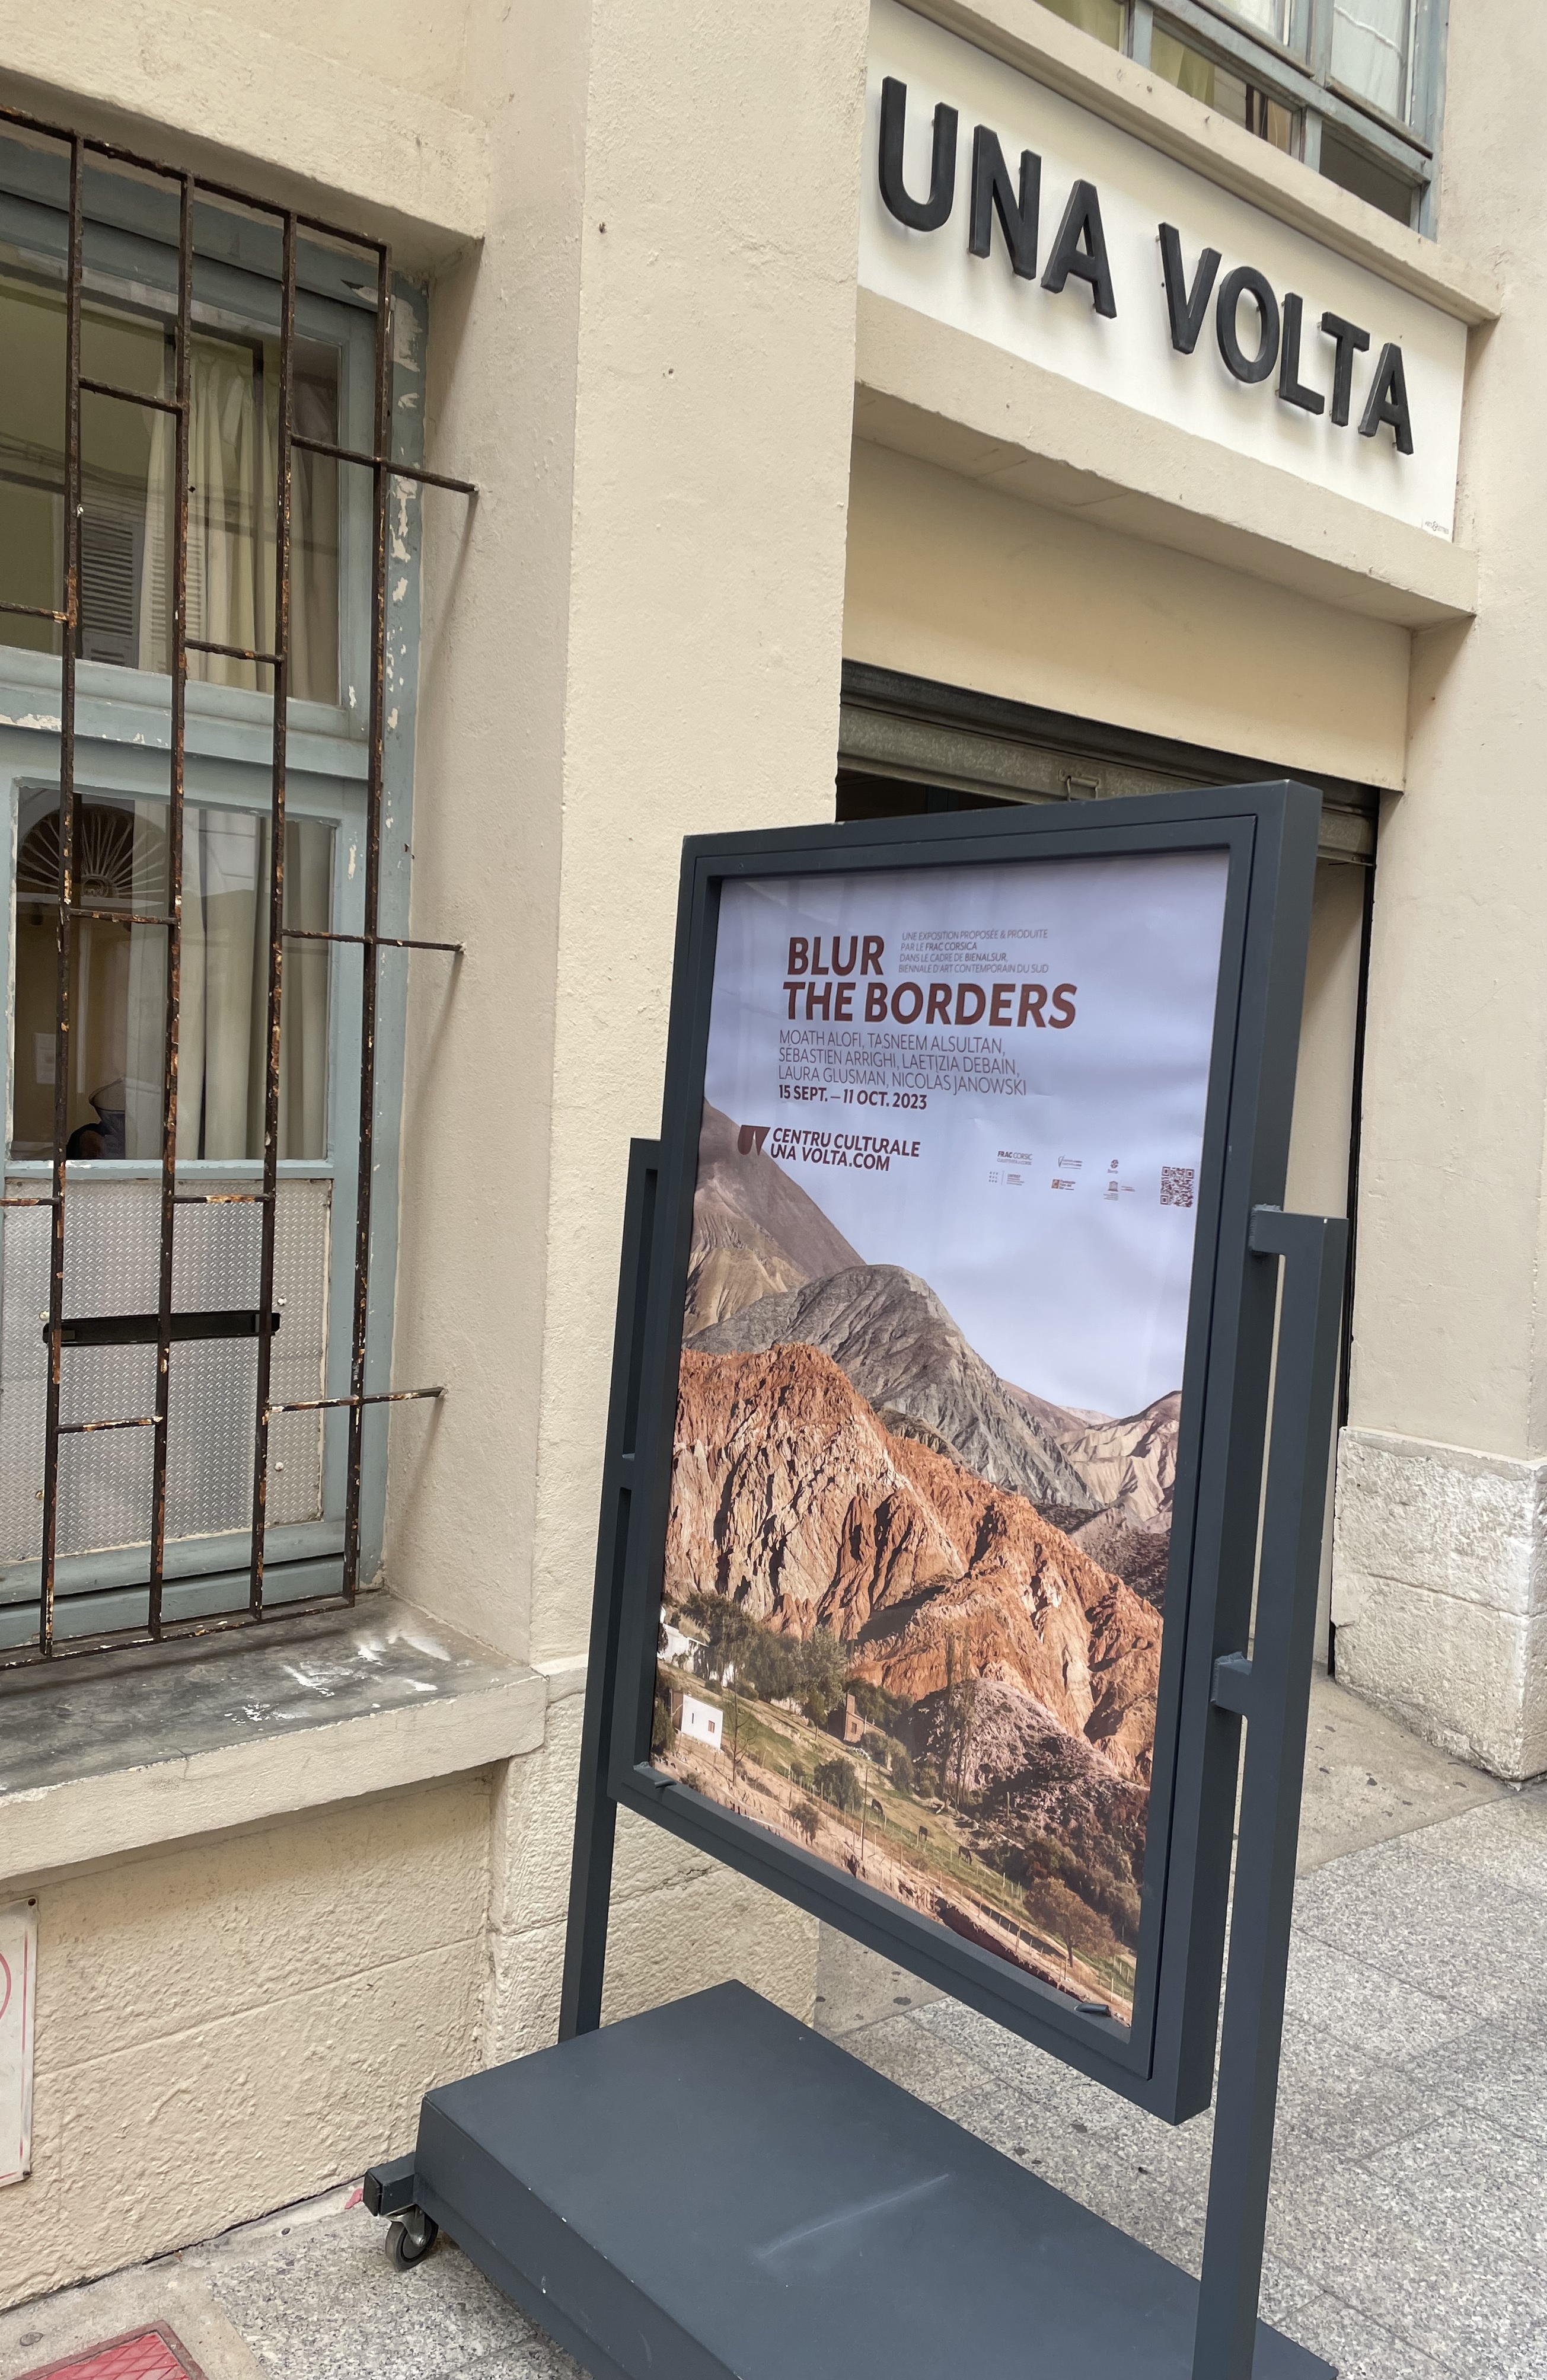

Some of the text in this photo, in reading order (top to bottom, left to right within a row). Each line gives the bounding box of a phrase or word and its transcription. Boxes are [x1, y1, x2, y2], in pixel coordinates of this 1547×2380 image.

[879, 75, 1414, 455] UNA VOLTA
[901, 943, 915, 951] PAR
[924, 943, 944, 951] FRAC
[944, 942, 978, 951] CORSICA
[902, 929, 1048, 941] UNE EXPOSITION PROPOSÉE & PRODUITE
[787, 935, 885, 976] BLUR
[898, 964, 1049, 973] BIENNALE D'ART CONTEMPORAIN DU SUD
[900, 953, 920, 962] DANS
[921, 954, 929, 962] LE
[930, 953, 953, 962] CADRE
[953, 953, 964, 962] DE
[783, 981, 1077, 1030] THE BORDERS
[779, 1030, 1006, 1056] MOATH ALOFI, TASNEEM ALSULTAN,
[779, 1044, 1020, 1078] SÉBASTIEN ARRIGHI, LAETIZIA DEBAIN,
[778, 1066, 821, 1082] LAURA
[823, 1068, 889, 1088] GLUSMAN,
[952, 1076, 1027, 1096] JANOWSKI
[779, 1084, 791, 1100] 15
[793, 1085, 828, 1101] SEPT.
[843, 1089, 854, 1104] 11
[856, 1090, 890, 1107] OCT.
[892, 1092, 927, 1110] 2023
[773, 1127, 921, 1157] CENTRU CULTURALE
[770, 1143, 890, 1171] UNA VOLTA.COM
